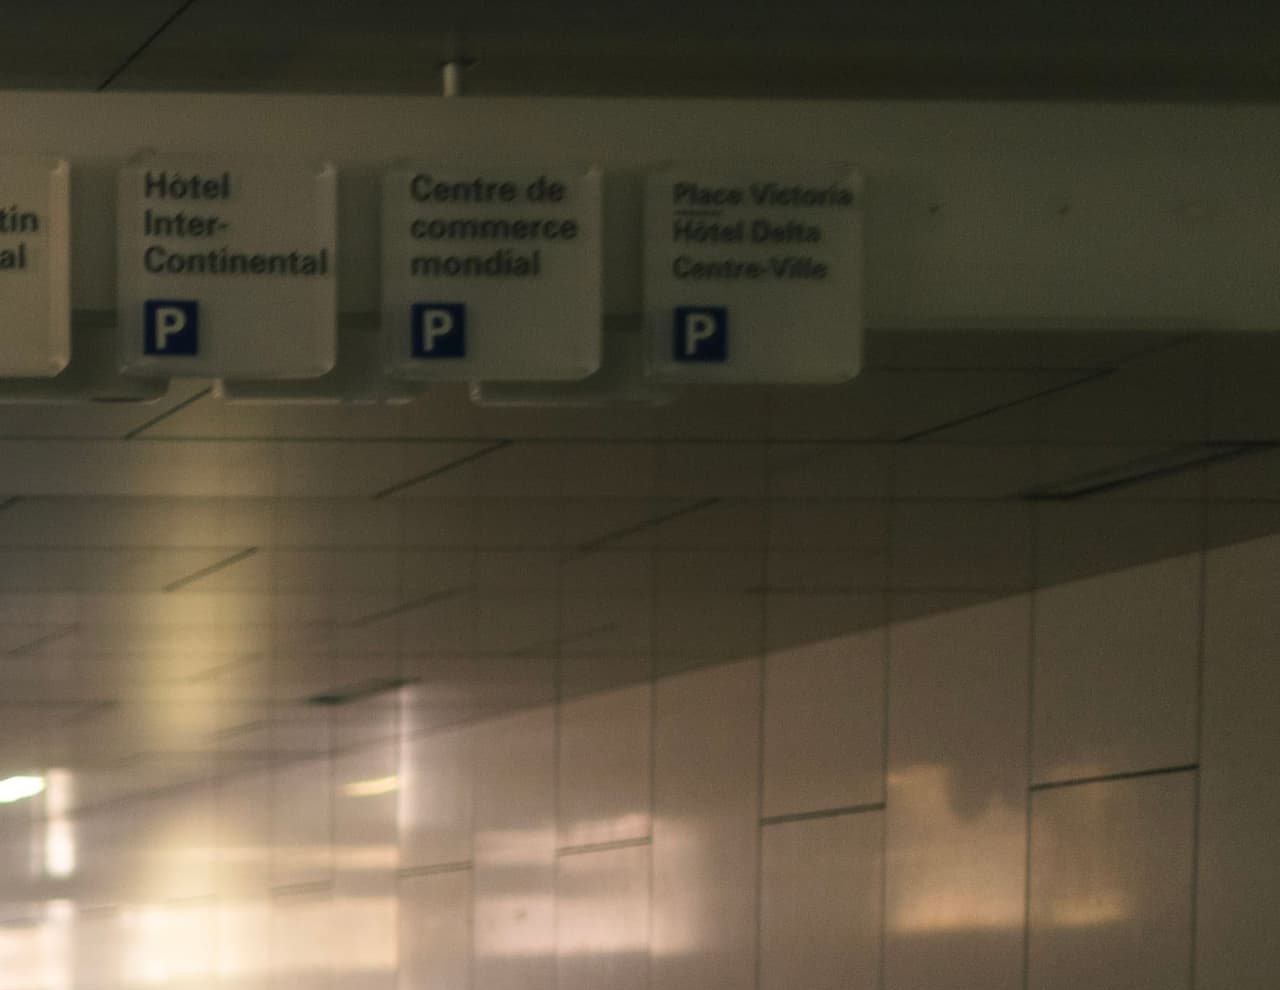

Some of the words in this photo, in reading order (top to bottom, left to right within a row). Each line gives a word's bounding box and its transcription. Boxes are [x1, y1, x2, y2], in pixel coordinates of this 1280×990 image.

[144, 171, 231, 200] Hôtel
[410, 173, 517, 203] Centre
[526, 175, 566, 203] de
[673, 181, 743, 207] Place
[749, 182, 855, 207] Victoria
[144, 208, 231, 238] Inter-
[410, 218, 579, 241] commerce
[673, 219, 744, 243] Hôtel
[752, 220, 822, 243] Delta
[144, 246, 329, 276] Continental
[410, 248, 541, 278] mondial
[673, 256, 829, 281] Centre-Ville
[155, 307, 186, 350] P
[423, 310, 454, 351] P
[685, 314, 717, 356] P
